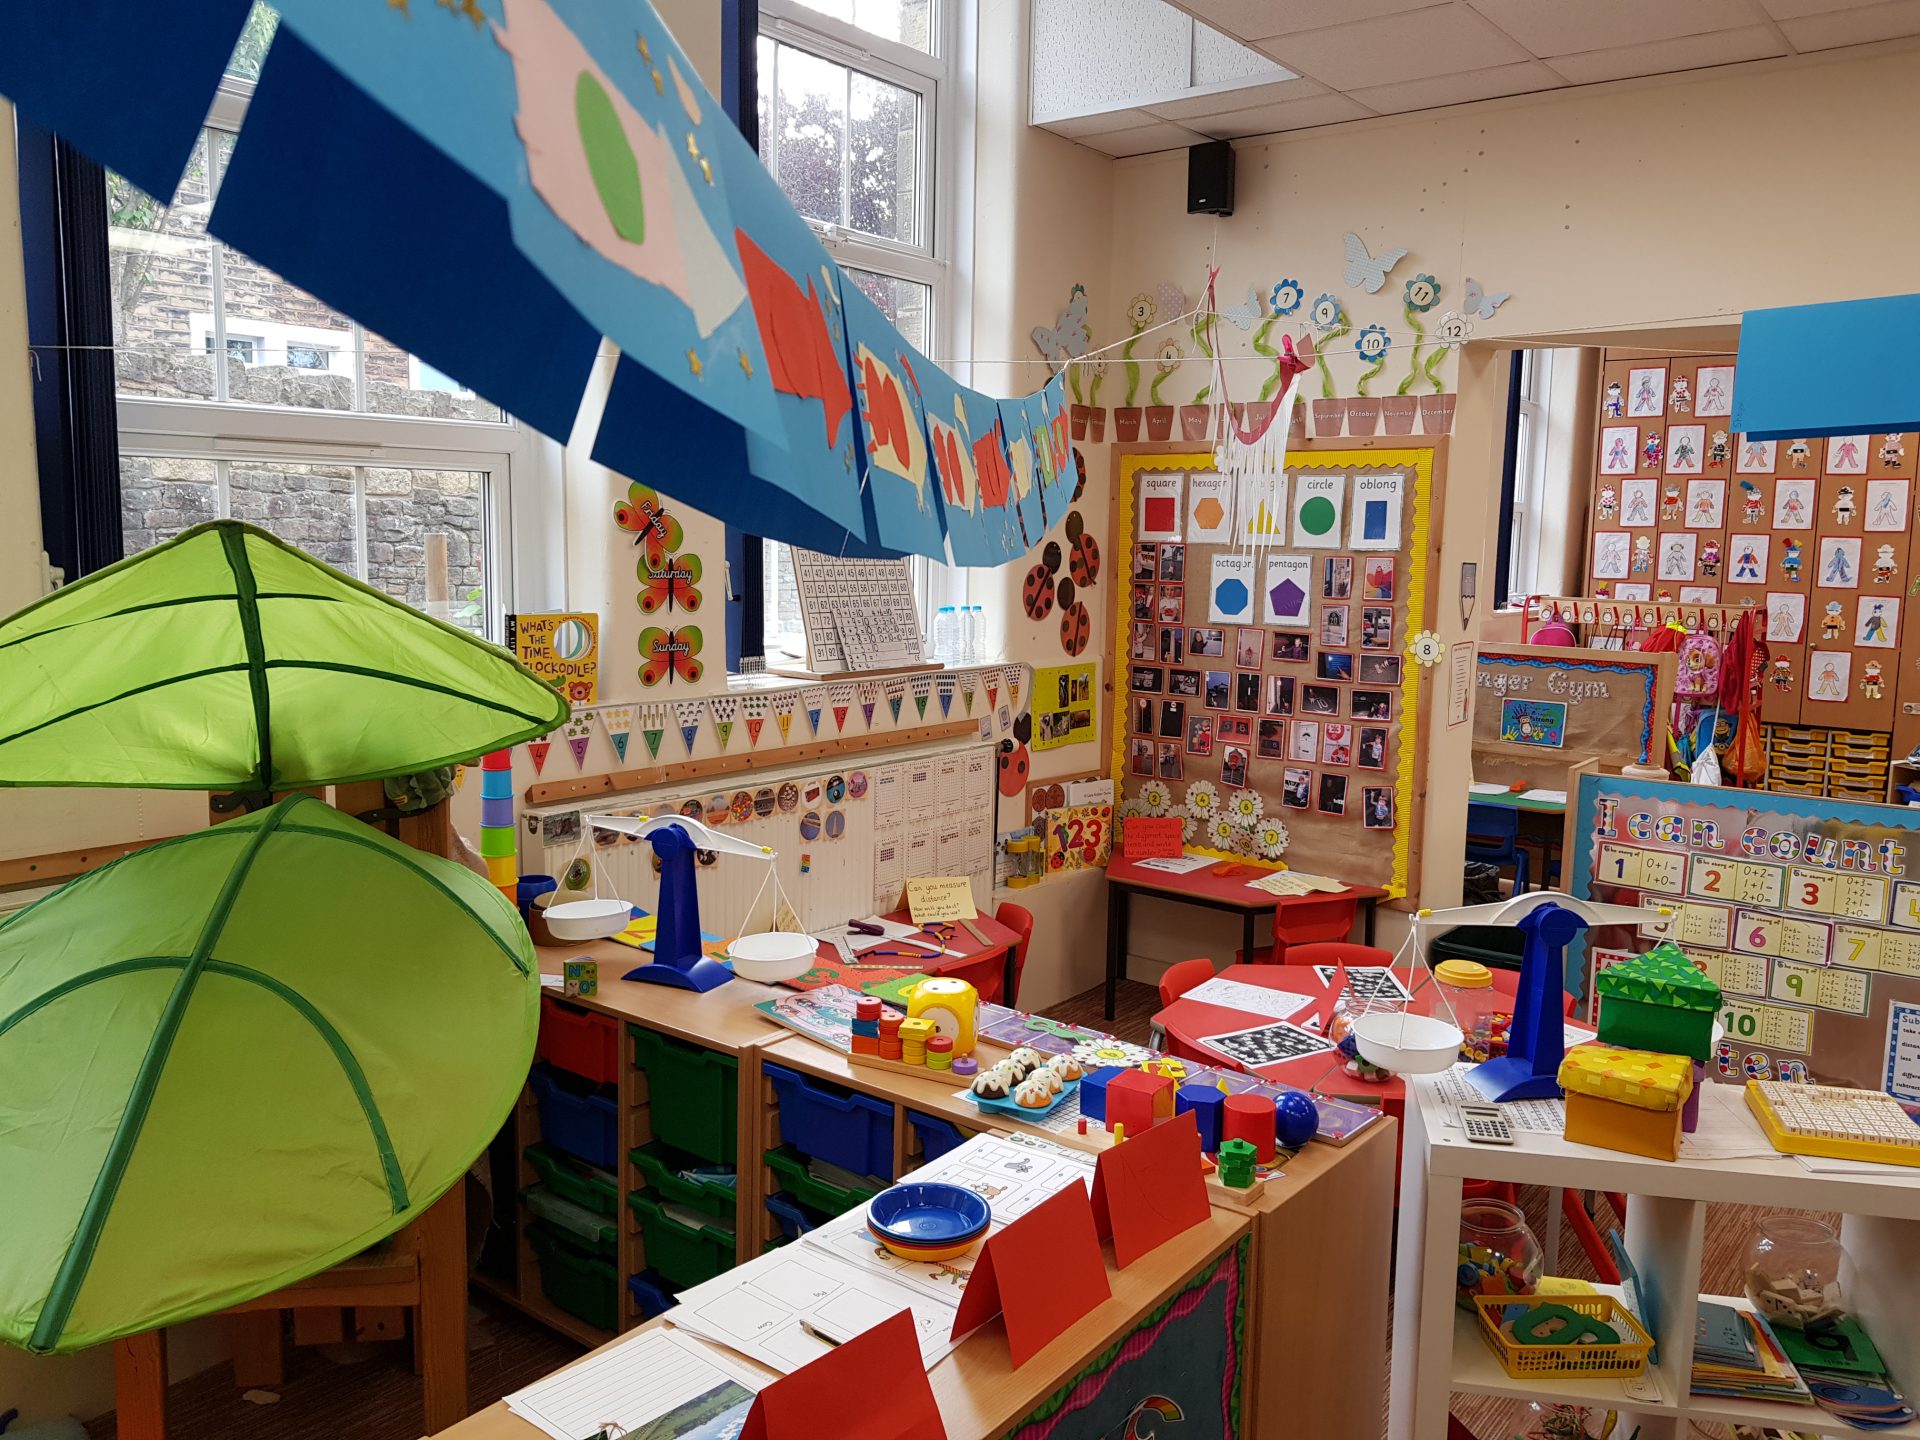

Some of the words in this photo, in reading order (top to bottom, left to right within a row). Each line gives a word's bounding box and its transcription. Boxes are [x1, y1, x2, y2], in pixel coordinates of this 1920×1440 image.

[1284, 292, 1290, 303] 7
[1414, 286, 1429, 302] 11
[1138, 306, 1144, 317] 3
[1321, 307, 1328, 319] 9
[1447, 325, 1461, 337] 12
[1366, 339, 1379, 350] 10
[1151, 417, 1167, 425] April
[1146, 479, 1176, 491] square
[1307, 479, 1334, 490] circle
[1360, 478, 1397, 493] oblong
[641, 501, 667, 538] Friday
[1269, 560, 1308, 572] pentagon
[804, 569, 810, 578] 41
[815, 569, 822, 577] 42
[826, 569, 833, 577] 43
[837, 569, 844, 577] 44
[848, 569, 854, 577] 45
[858, 569, 865, 577] 46
[888, 568, 894, 576] 49
[898, 568, 904, 576] 50
[806, 585, 813, 594] 51
[818, 585, 825, 593] 52
[829, 585, 836, 593] 53
[840, 585, 847, 593] 54
[850, 584, 857, 592] 55
[861, 584, 867, 592] 56
[871, 584, 877, 592] 57
[881, 584, 887, 592] 58
[891, 583, 897, 592] 59
[809, 601, 816, 610] 61
[821, 601, 828, 609] 62
[832, 600, 838, 609] 63
[843, 600, 849, 608] 64
[520, 619, 554, 634] WHAT'S
[812, 617, 819, 626] 71
[823, 616, 830, 625] 72
[529, 634, 546, 645] THE
[815, 633, 822, 642] 81
[826, 633, 833, 641] 82
[653, 640, 689, 656] Sunday
[817, 649, 825, 657] 91
[829, 648, 836, 656] 92
[1423, 644, 1431, 655] 8
[523, 661, 597, 677] LOCKODILE?
[1012, 685, 1019, 696] 20
[1477, 671, 1534, 697] nger
[1547, 670, 1609, 705] Gym
[835, 707, 846, 720] 13
[749, 721, 761, 733] 10
[782, 716, 789, 728] 11
[687, 728, 693, 740] 8
[722, 725, 729, 736] 9
[618, 737, 624, 749] 6
[651, 732, 657, 745] 7
[535, 747, 543, 759] 4
[577, 742, 584, 754] 5
[1598, 799, 1618, 837] I
[1628, 812, 1724, 849] can
[1741, 826, 1905, 874] count
[1615, 858, 1625, 879] 1
[1703, 869, 1722, 893] 2
[908, 881, 922, 892] Can
[926, 884, 938, 894] you
[939, 881, 967, 889] measure
[1801, 882, 1819, 905] 3
[920, 893, 950, 903] distance?
[1749, 926, 1767, 948] 6
[1847, 938, 1866, 961] 7
[1786, 974, 1803, 997] 9
[1724, 1011, 1756, 1036] 10
[1716, 1043, 1815, 1084] ten
